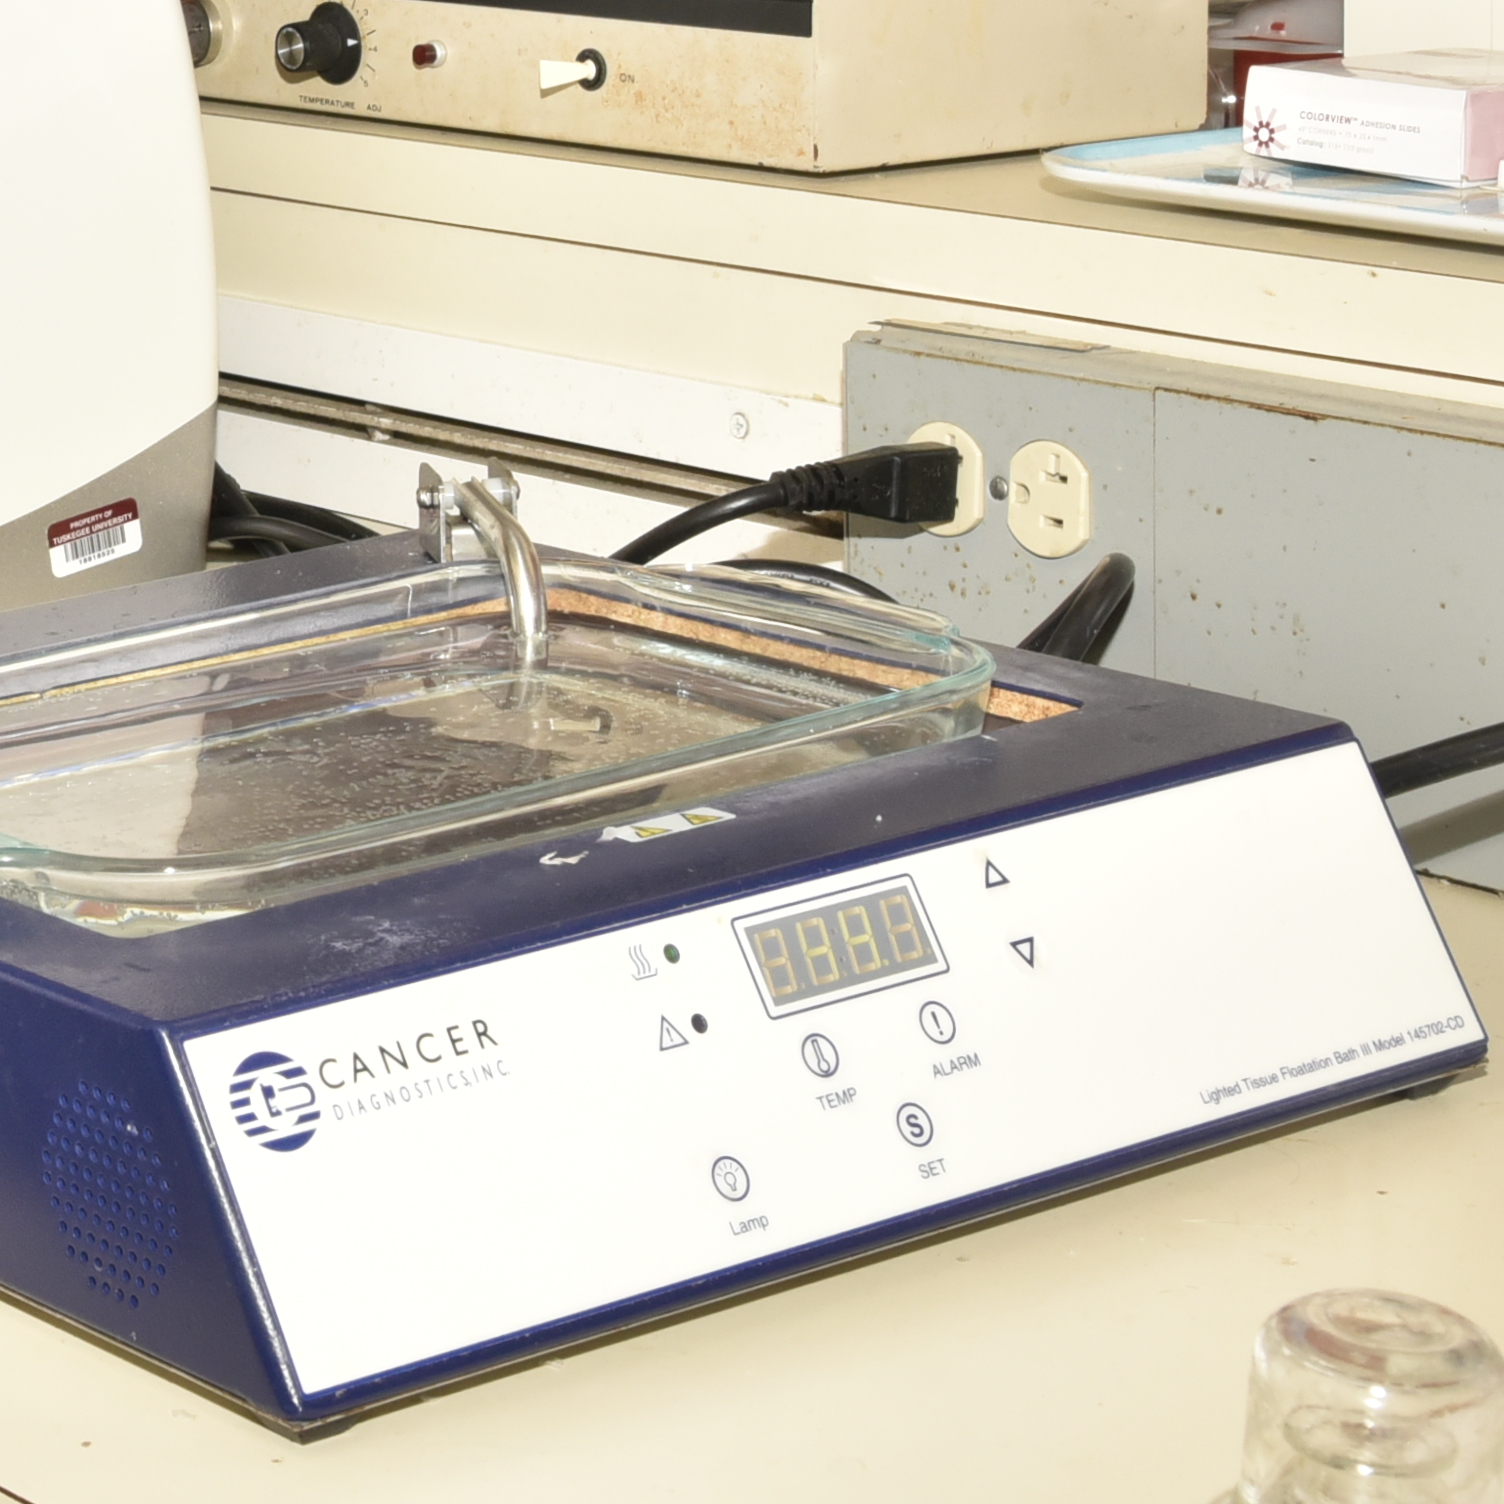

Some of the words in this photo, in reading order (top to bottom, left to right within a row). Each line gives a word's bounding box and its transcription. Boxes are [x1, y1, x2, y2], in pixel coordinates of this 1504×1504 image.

[619, 73, 635, 83] ON
[299, 95, 355, 109] TEMPERATURE
[366, 103, 382, 113] ADJ
[1360, 119, 1397, 131] ADHESION
[1399, 124, 1421, 134] SLIDES
[52, 527, 91, 545] TUSKEGEE
[91, 511, 133, 533] UNIVERSITY
[69, 512, 104, 529] PROPERTY
[104, 509, 113, 519] OF
[318, 1019, 499, 1089] CANCER
[931, 1051, 982, 1079] ALARM
[1199, 1081, 1242, 1106] Lighted
[1242, 1070, 1280, 1092] Tissue
[1279, 1056, 1333, 1081] Floatation
[1332, 1045, 1360, 1065] Bath
[1359, 1041, 1373, 1057] III
[1372, 1032, 1406, 1053] Model
[1406, 1015, 1466, 1043] 145702-CD
[816, 1087, 858, 1112] TEMP
[917, 1157, 947, 1181] SET
[729, 1213, 770, 1237] Lamp
